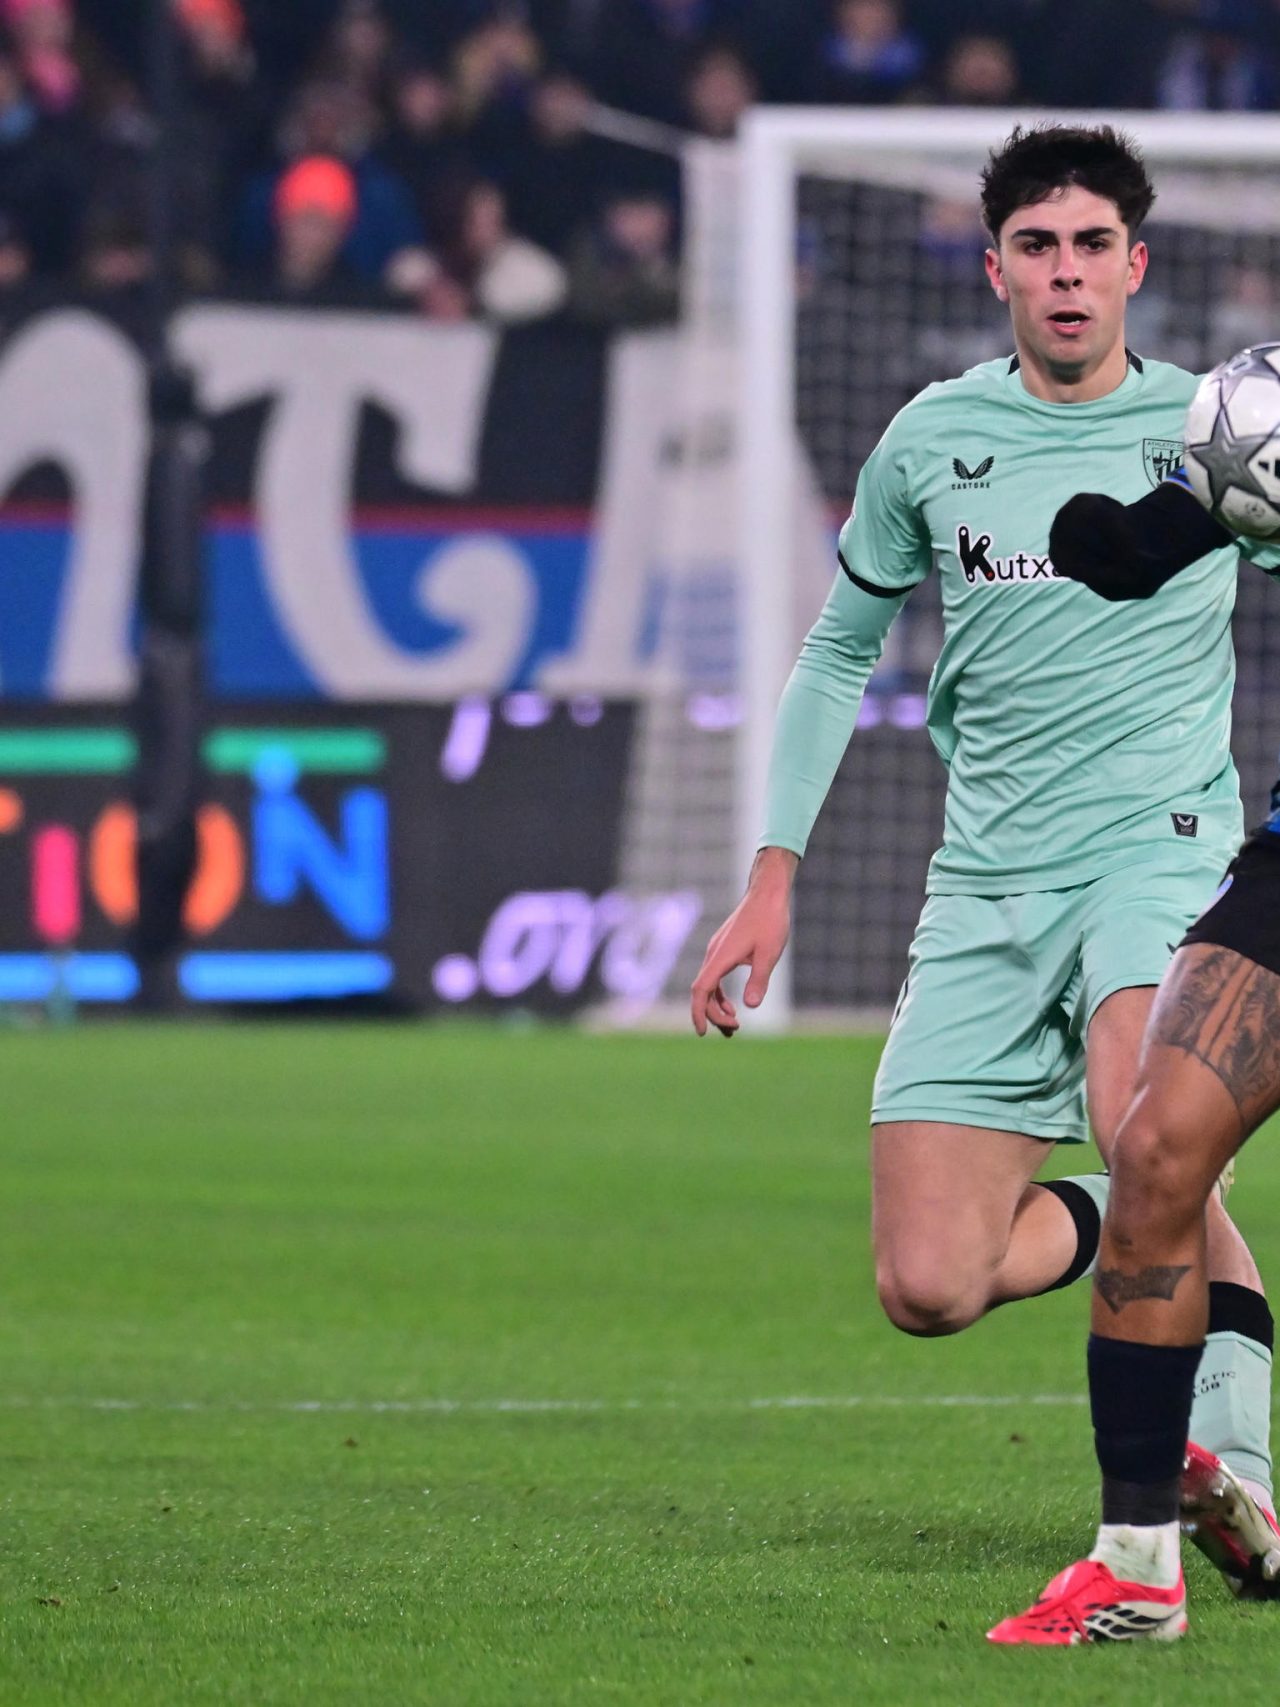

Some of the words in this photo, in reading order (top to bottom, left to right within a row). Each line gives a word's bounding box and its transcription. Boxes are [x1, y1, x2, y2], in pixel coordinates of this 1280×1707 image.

[951, 482, 991, 490] CASTORE
[0, 770, 392, 945] ION
[1201, 1370, 1237, 1385] ETIC
[1191, 1381, 1221, 1399] LUB
